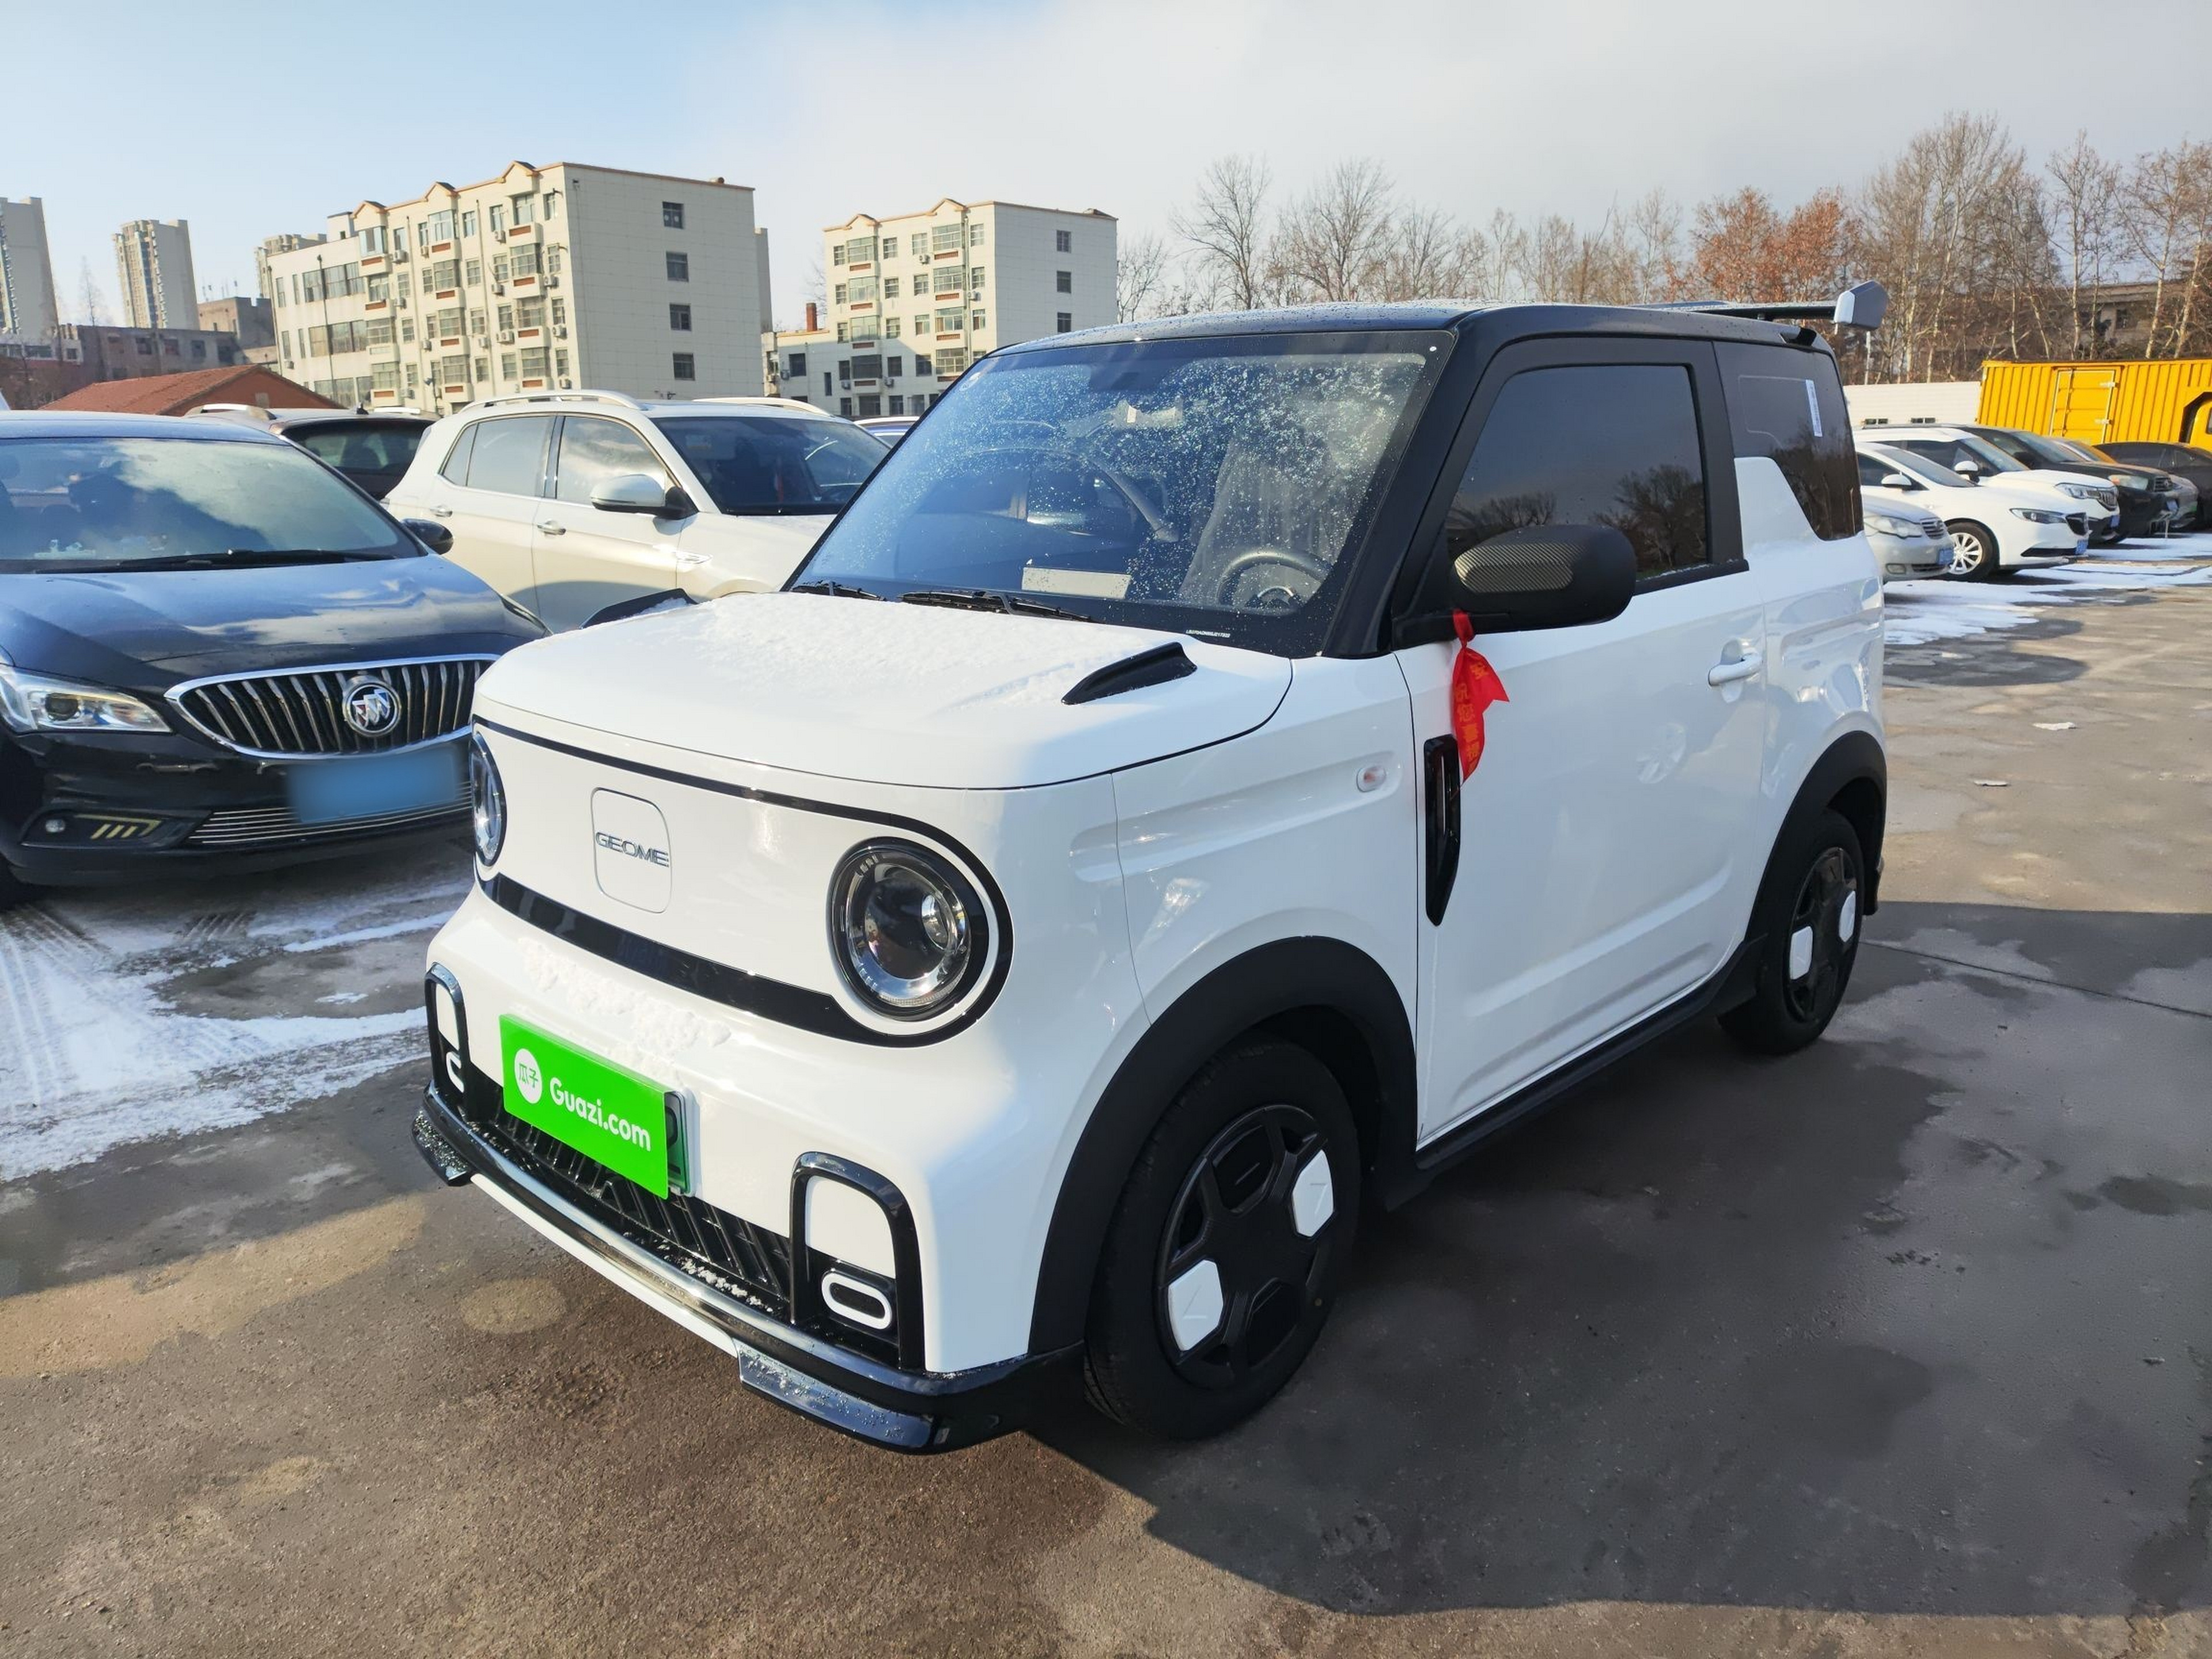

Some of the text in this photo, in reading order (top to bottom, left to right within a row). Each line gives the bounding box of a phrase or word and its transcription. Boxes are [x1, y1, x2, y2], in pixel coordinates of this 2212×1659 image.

[596, 832, 669, 868] GEOME
[518, 1062, 539, 1089] 瓜子
[549, 1077, 652, 1152] Guazi.com
